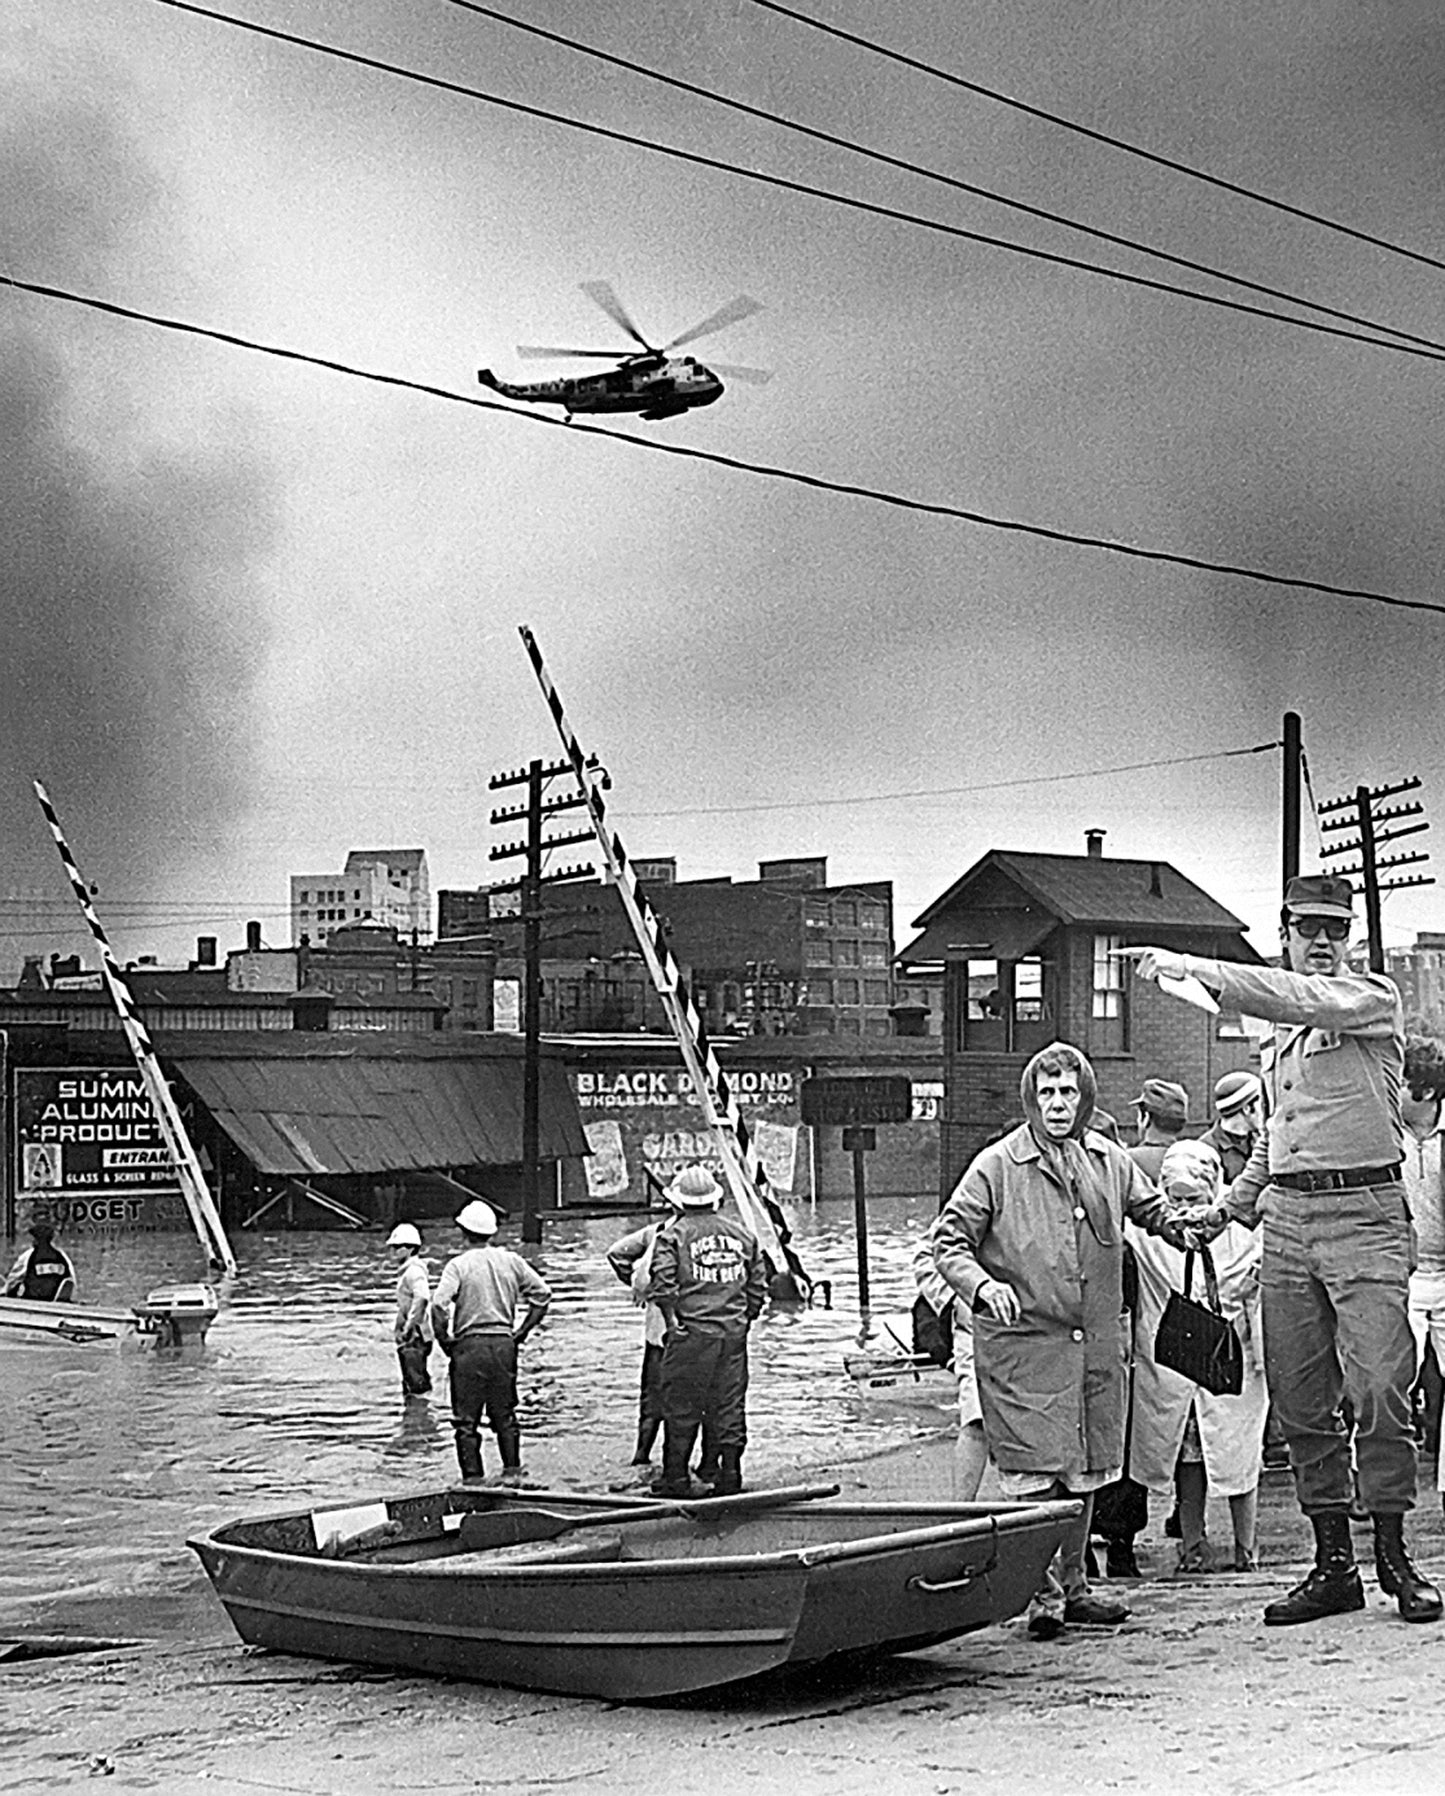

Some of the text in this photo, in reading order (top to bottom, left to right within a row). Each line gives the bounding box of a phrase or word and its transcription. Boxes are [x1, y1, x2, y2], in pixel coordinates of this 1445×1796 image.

[58, 1080, 177, 1099] SUMM
[576, 1072, 794, 1094] BLACK DMOND
[41, 1102, 194, 1121] ALUMINM
[41, 1123, 168, 1143] PRODUCT
[109, 1150, 170, 1165] ENTRAN
[65, 1172, 100, 1184] GLASS
